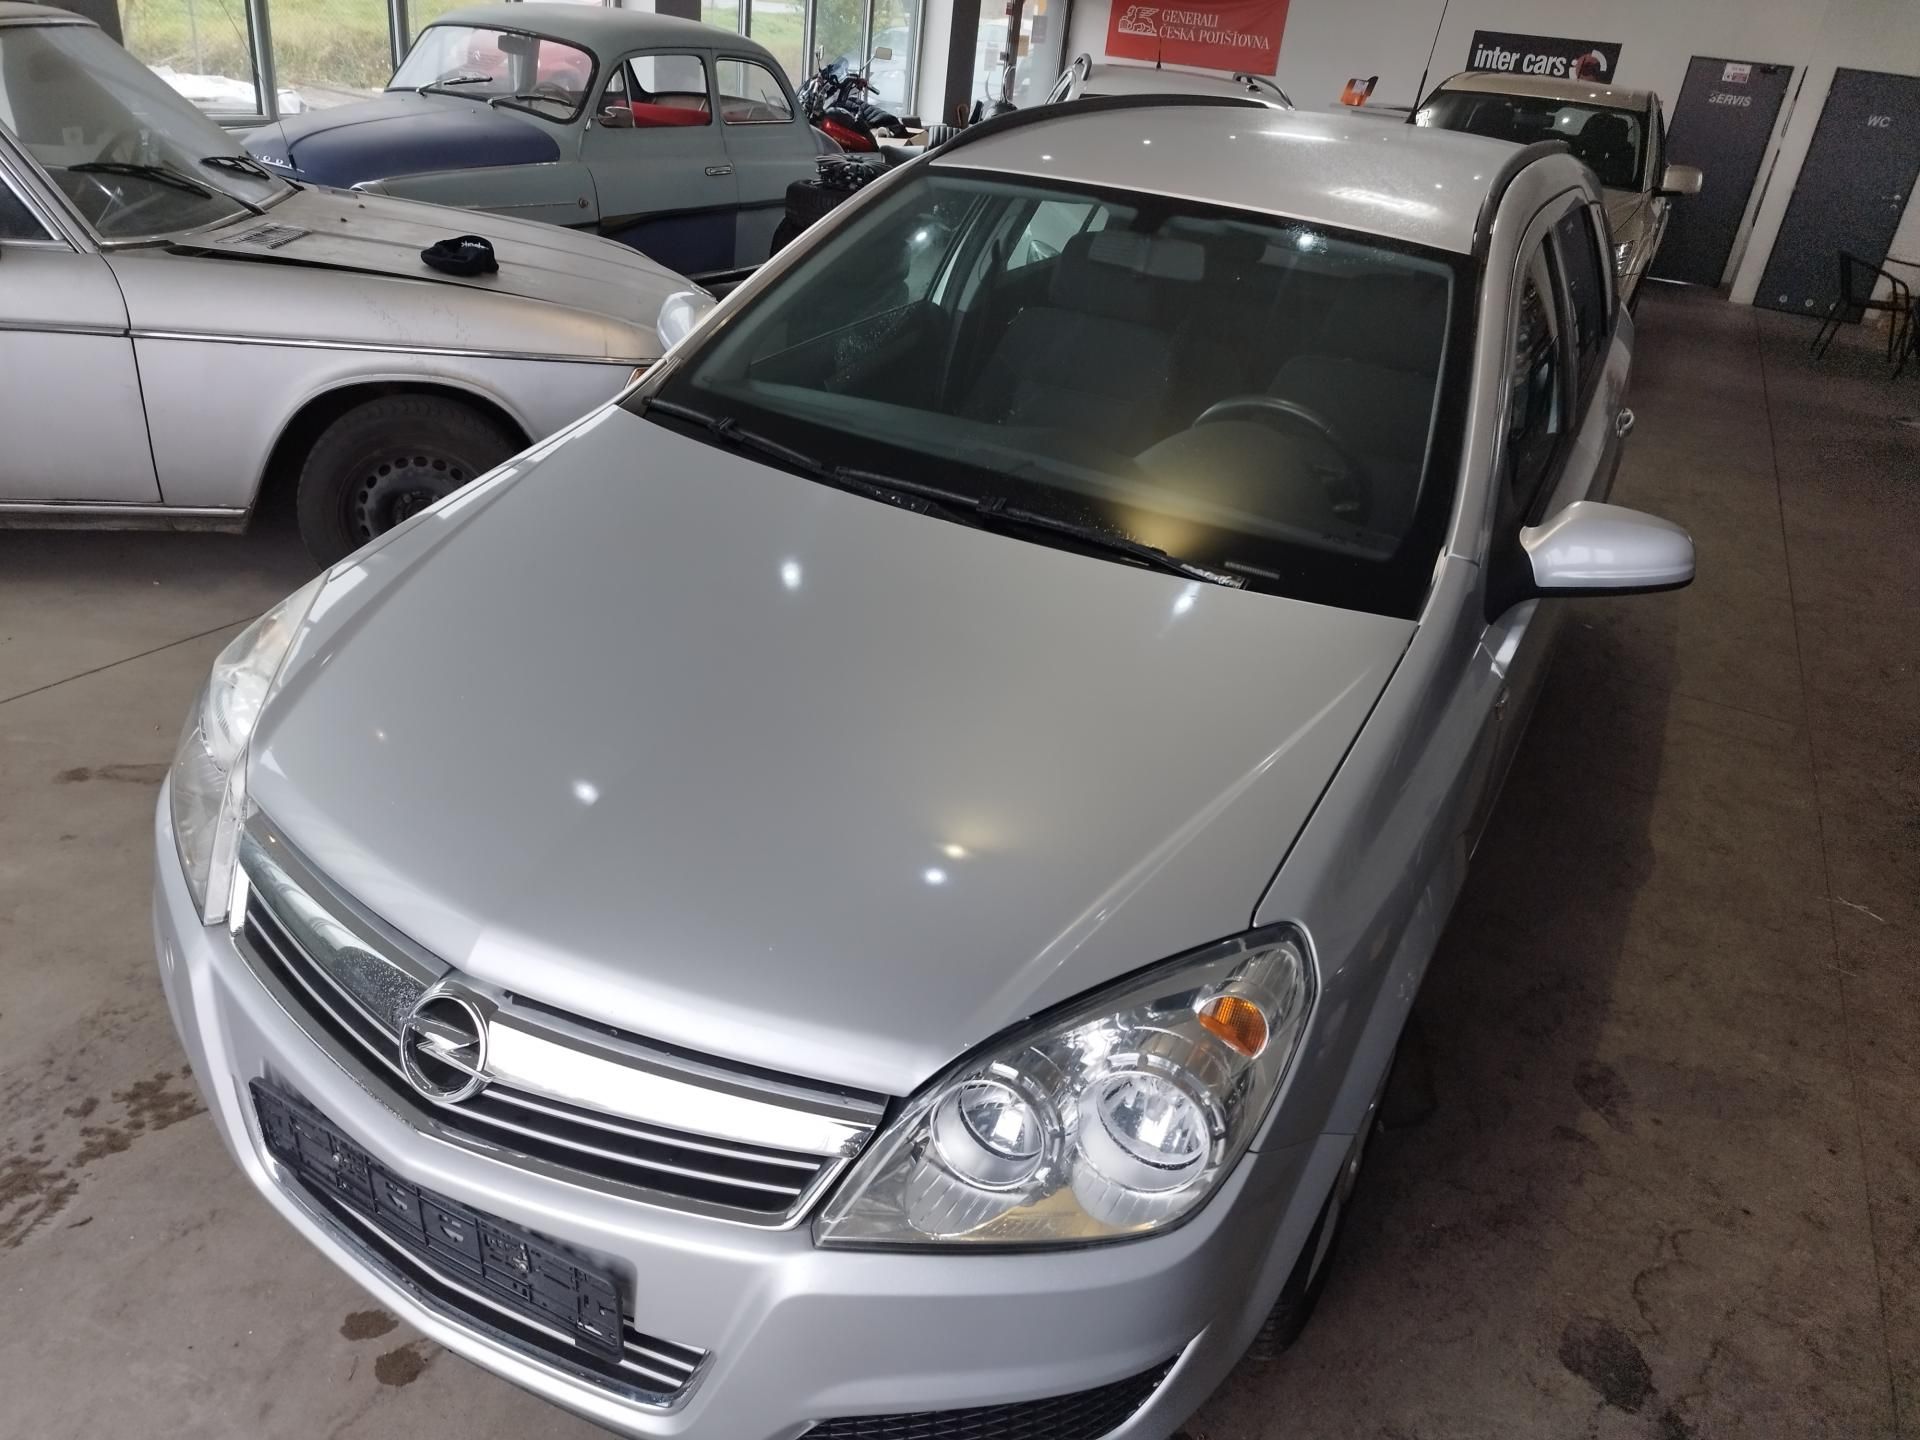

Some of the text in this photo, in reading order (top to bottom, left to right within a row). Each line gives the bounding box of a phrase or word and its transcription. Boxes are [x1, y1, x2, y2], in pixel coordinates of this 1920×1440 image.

[1162, 9, 1219, 28] GENERALI
[1159, 24, 1270, 50] ČESKÁ POJIŠŤOVNA
[1473, 44, 1567, 77] inter cars
[1708, 92, 1751, 107] SERVIS
[1867, 115, 1892, 128] WC
